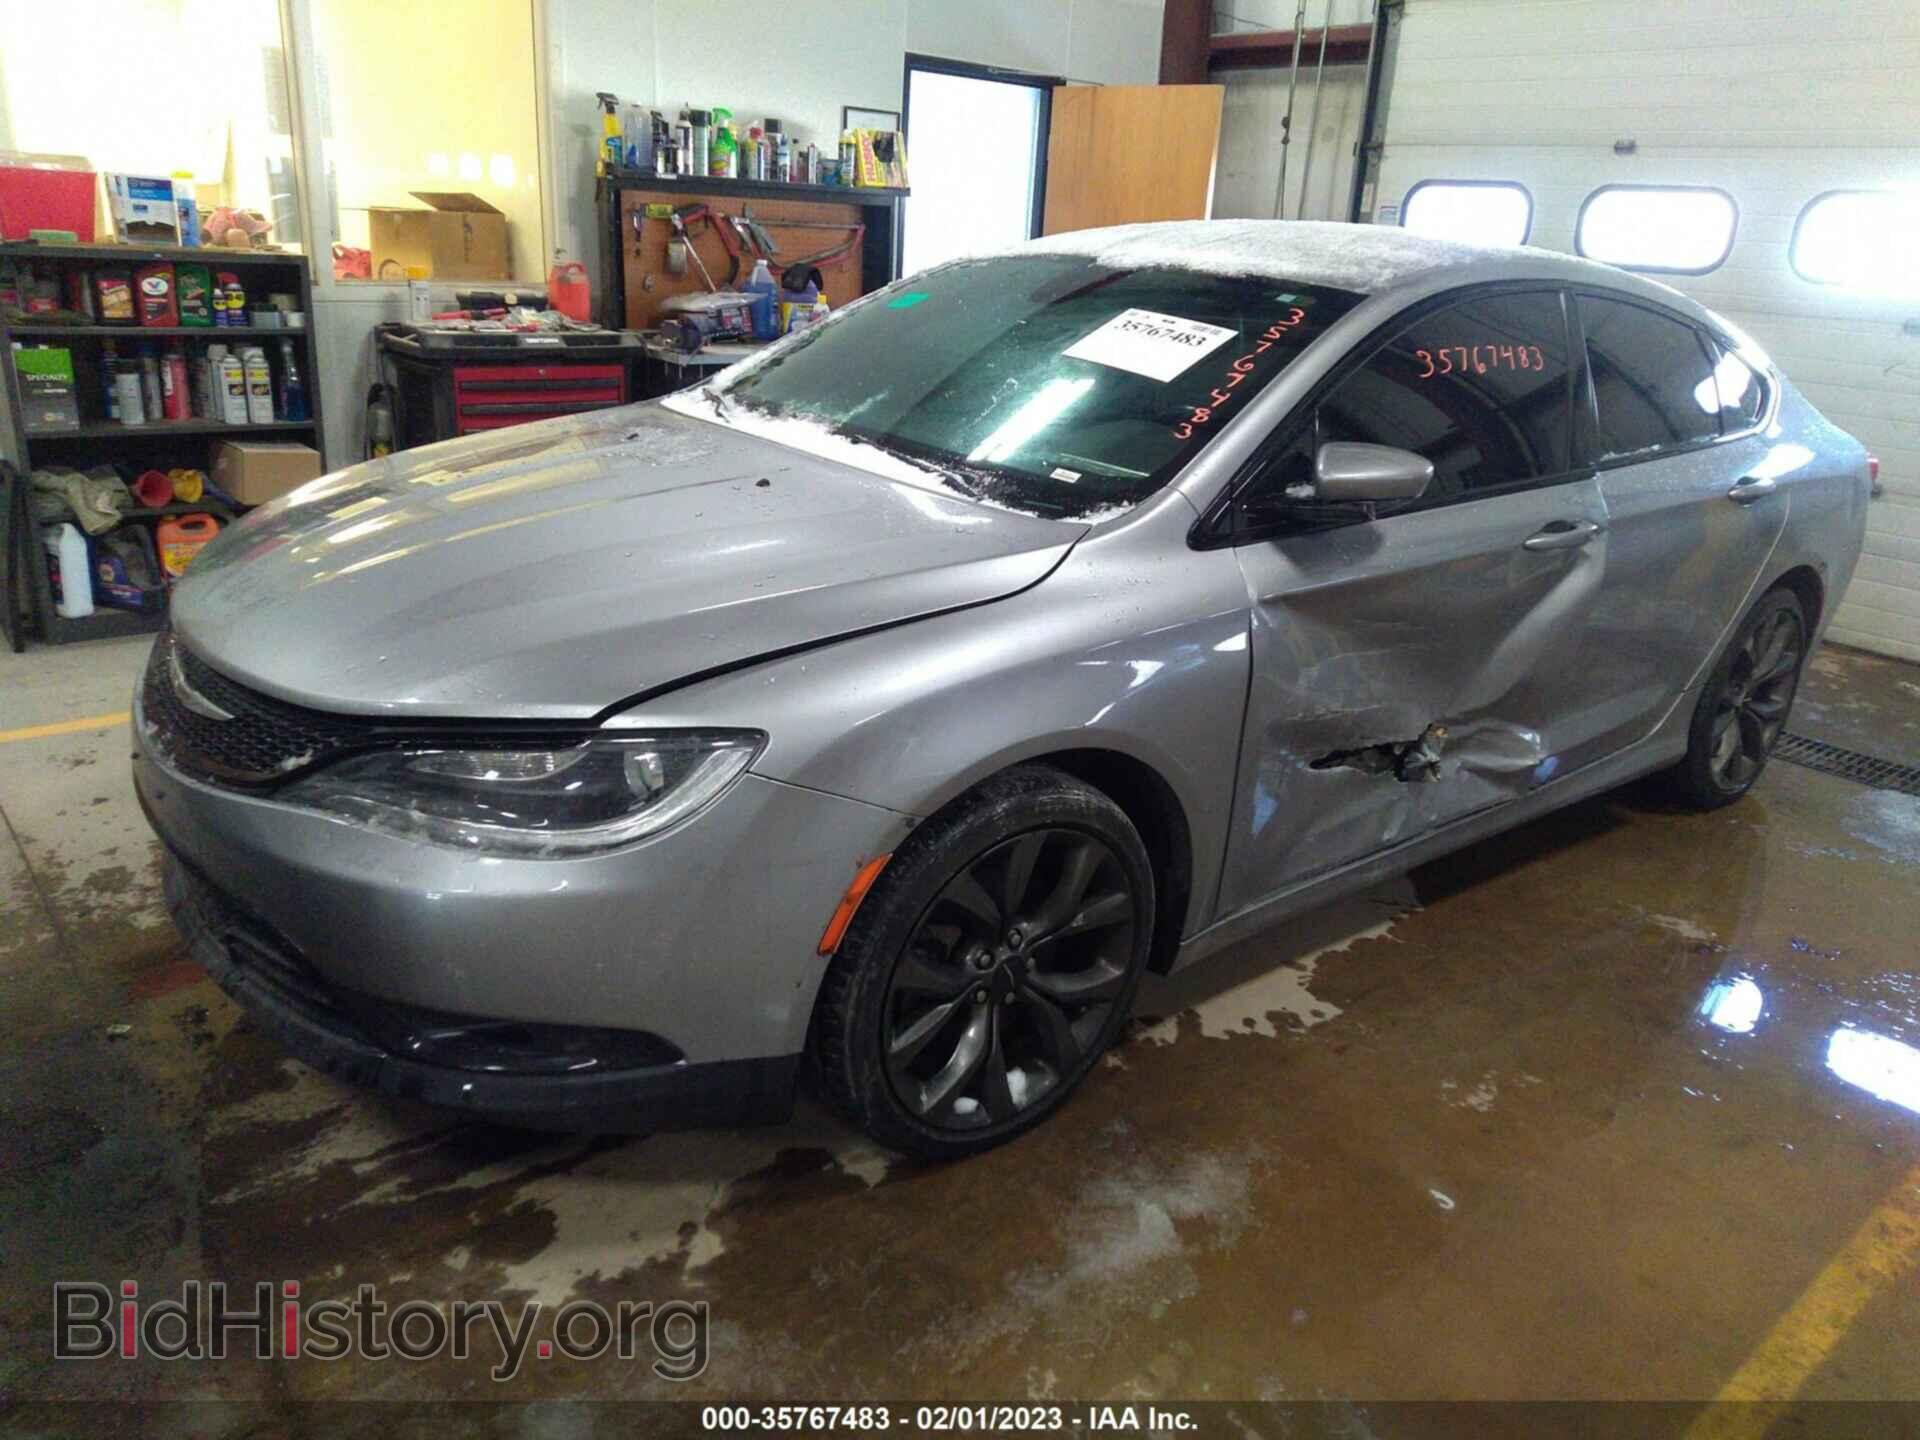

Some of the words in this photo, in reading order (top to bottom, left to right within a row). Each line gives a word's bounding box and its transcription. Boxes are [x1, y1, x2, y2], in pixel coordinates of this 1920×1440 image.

[1114, 320, 1206, 346] 35767483
[1173, 307, 1304, 439] 35767483
[1416, 345, 1544, 378] 35767483
